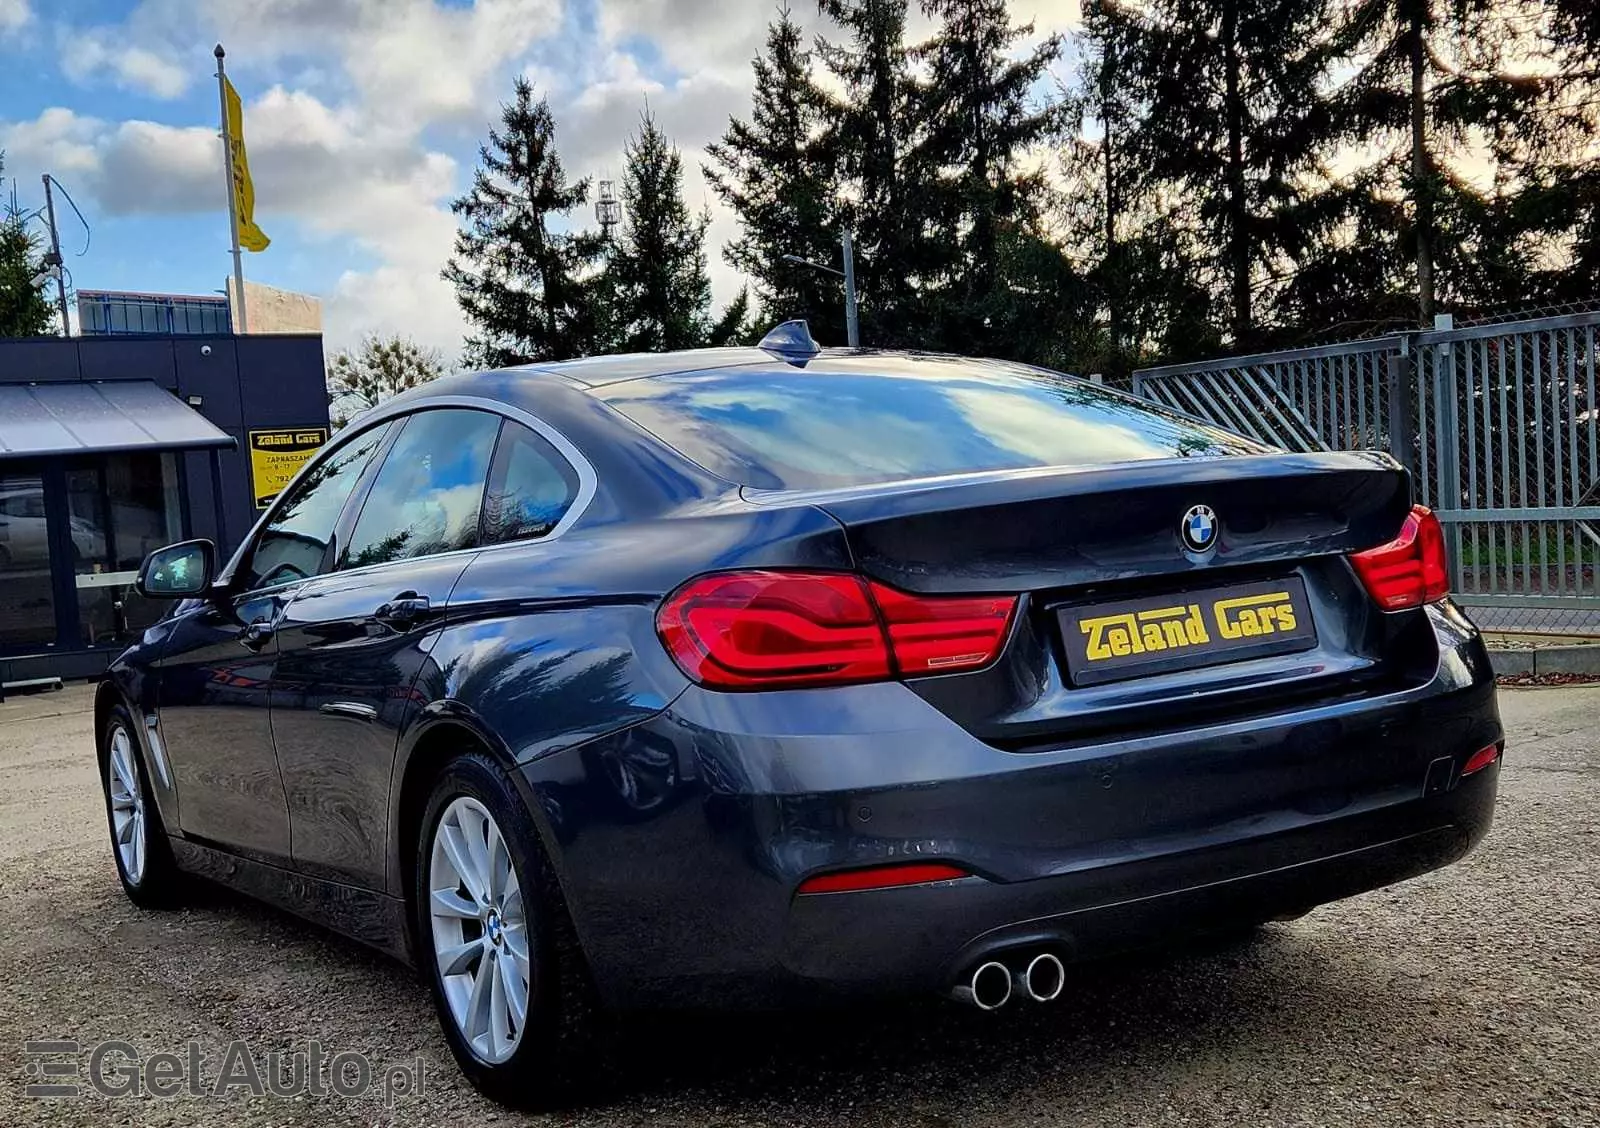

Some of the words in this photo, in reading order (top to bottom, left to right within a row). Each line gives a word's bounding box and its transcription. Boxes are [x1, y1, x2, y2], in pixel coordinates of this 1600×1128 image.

[257, 435, 293, 445] Zeland
[296, 433, 320, 444] Cars
[1187, 506, 1215, 522] BMW
[1080, 605, 1209, 660] Zeland
[1214, 591, 1296, 639] Cars
